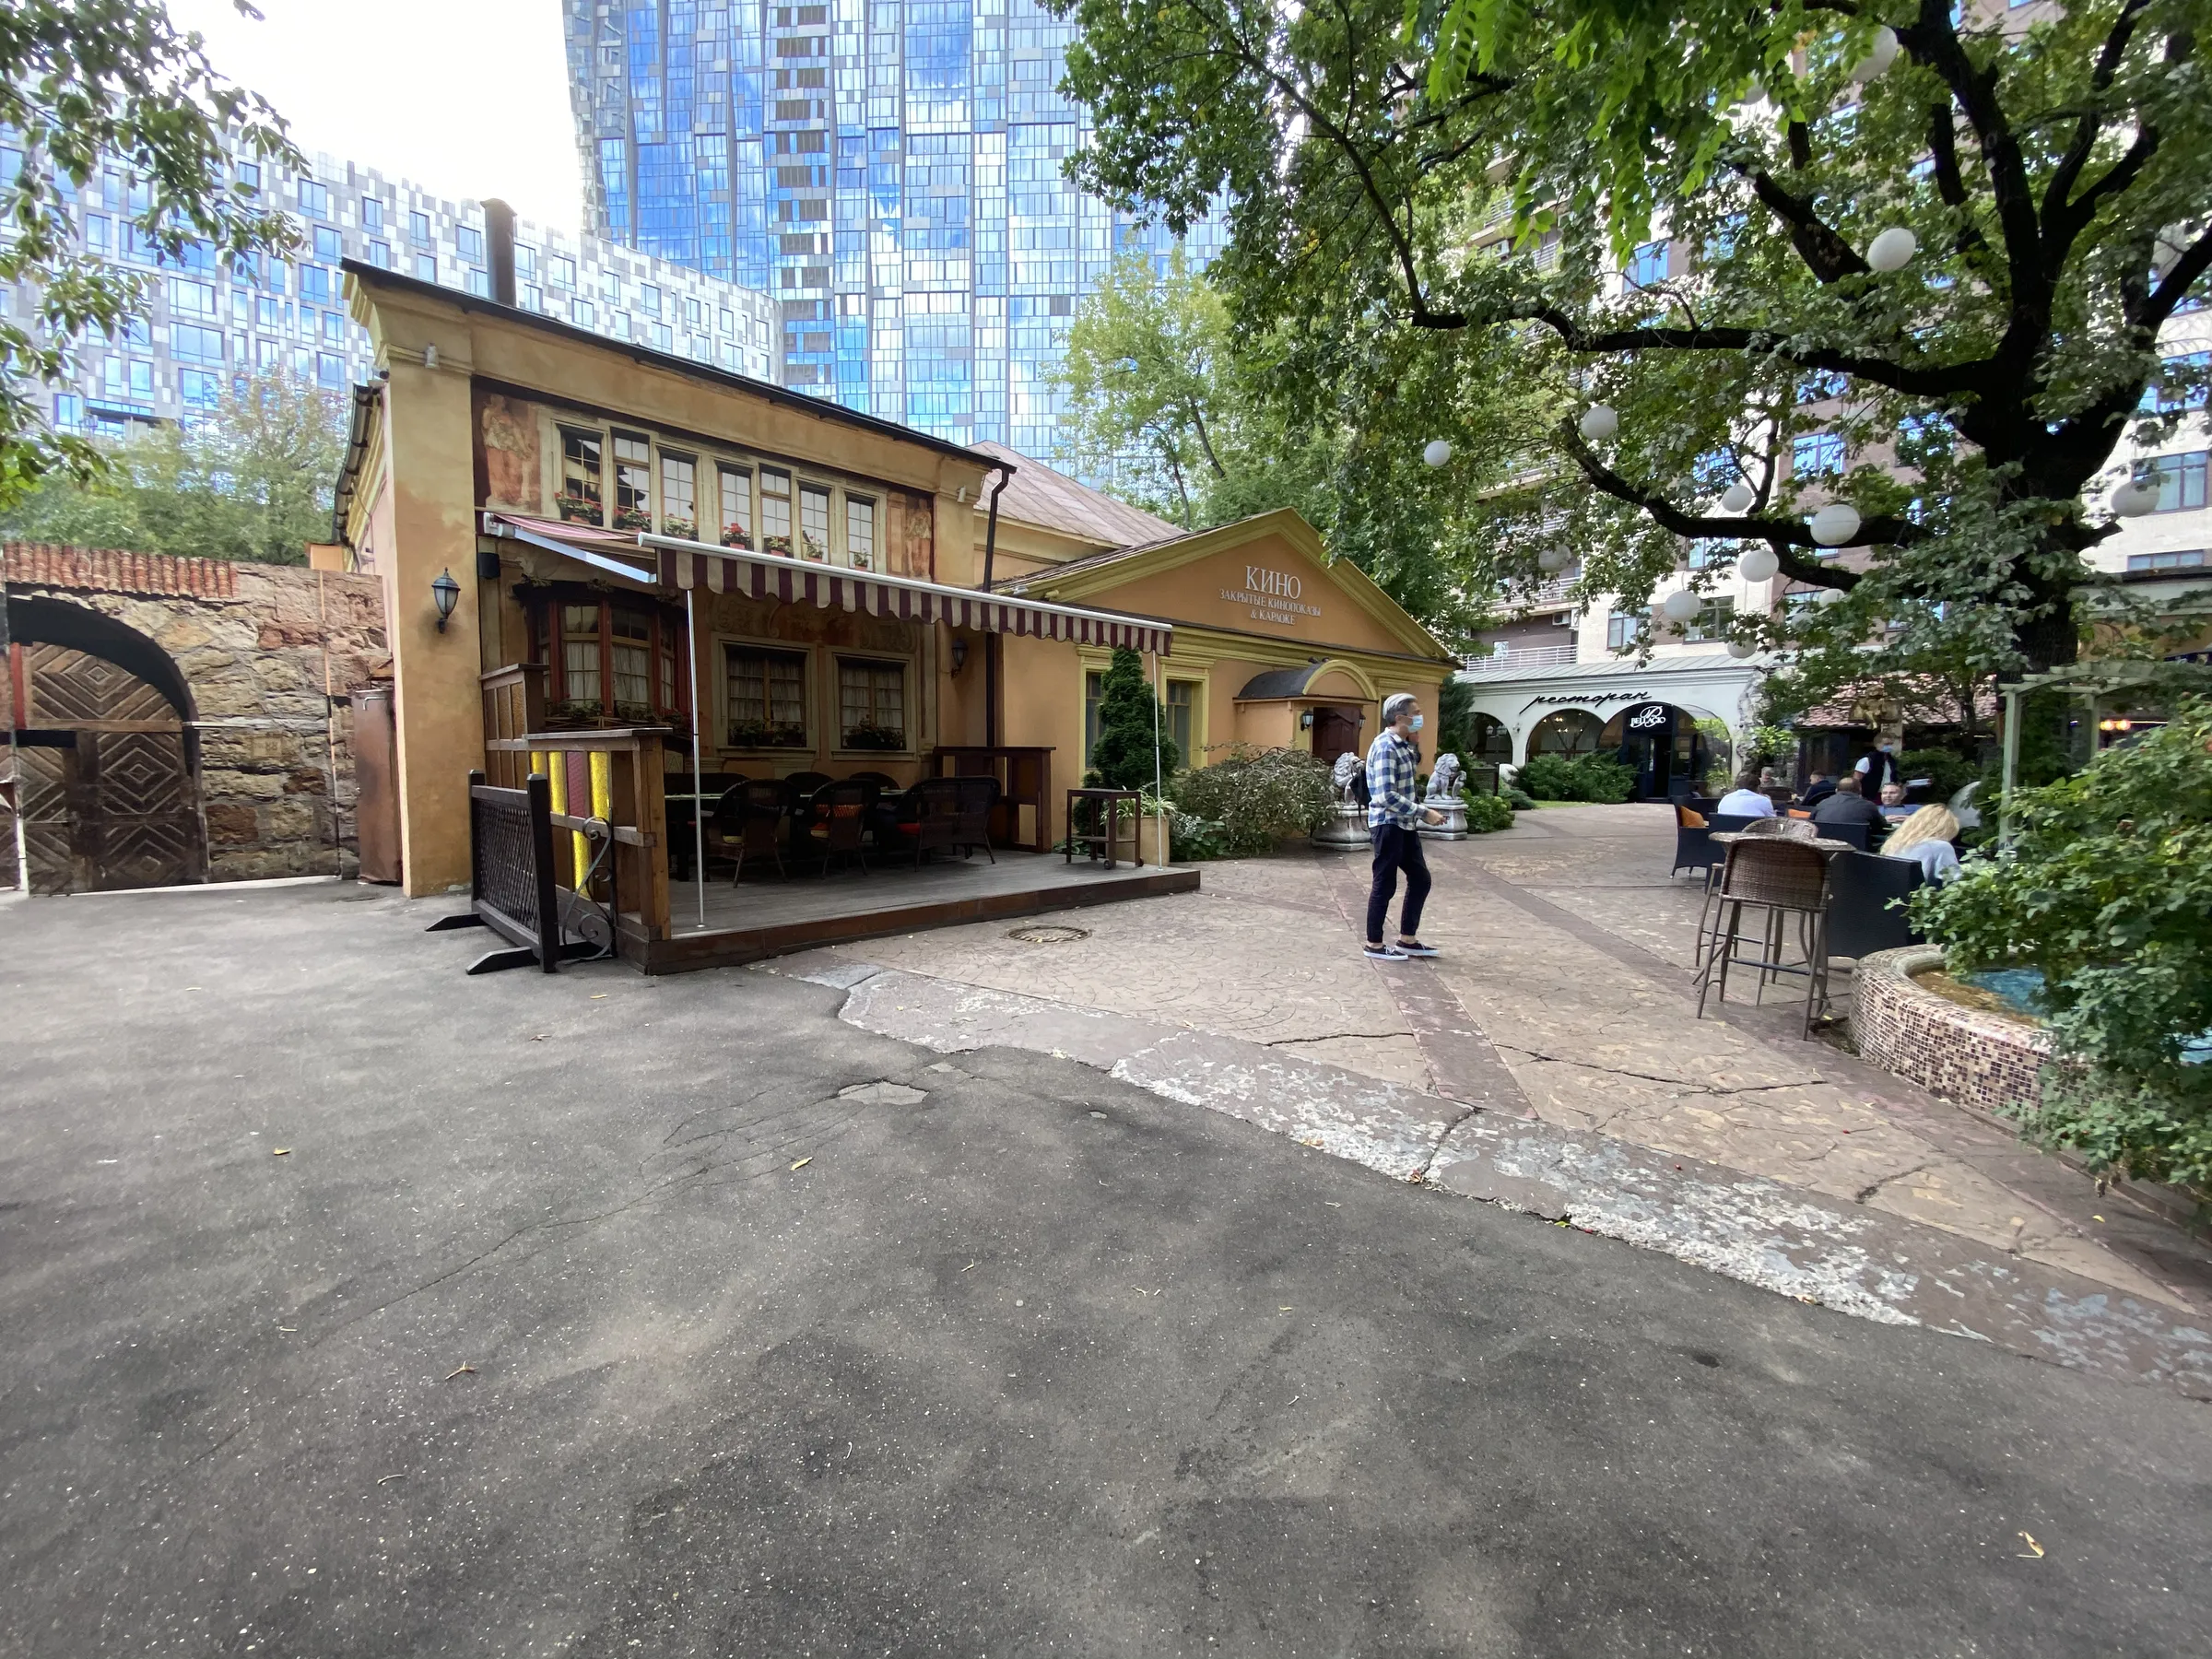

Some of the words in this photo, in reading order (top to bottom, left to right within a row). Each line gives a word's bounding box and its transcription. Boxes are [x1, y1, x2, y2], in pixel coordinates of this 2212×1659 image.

[1246, 566, 1300, 599] КИНО
[1220, 589, 1266, 607] ЗАКРЫТЫЕ
[1267, 597, 1321, 617] КИНОПОКАЗЫ
[1251, 609, 1257, 619] &
[1259, 609, 1296, 626] КАРАОКЕ
[1519, 691, 1653, 714] ресторан
[1631, 716, 1665, 724] BELLAGIO
